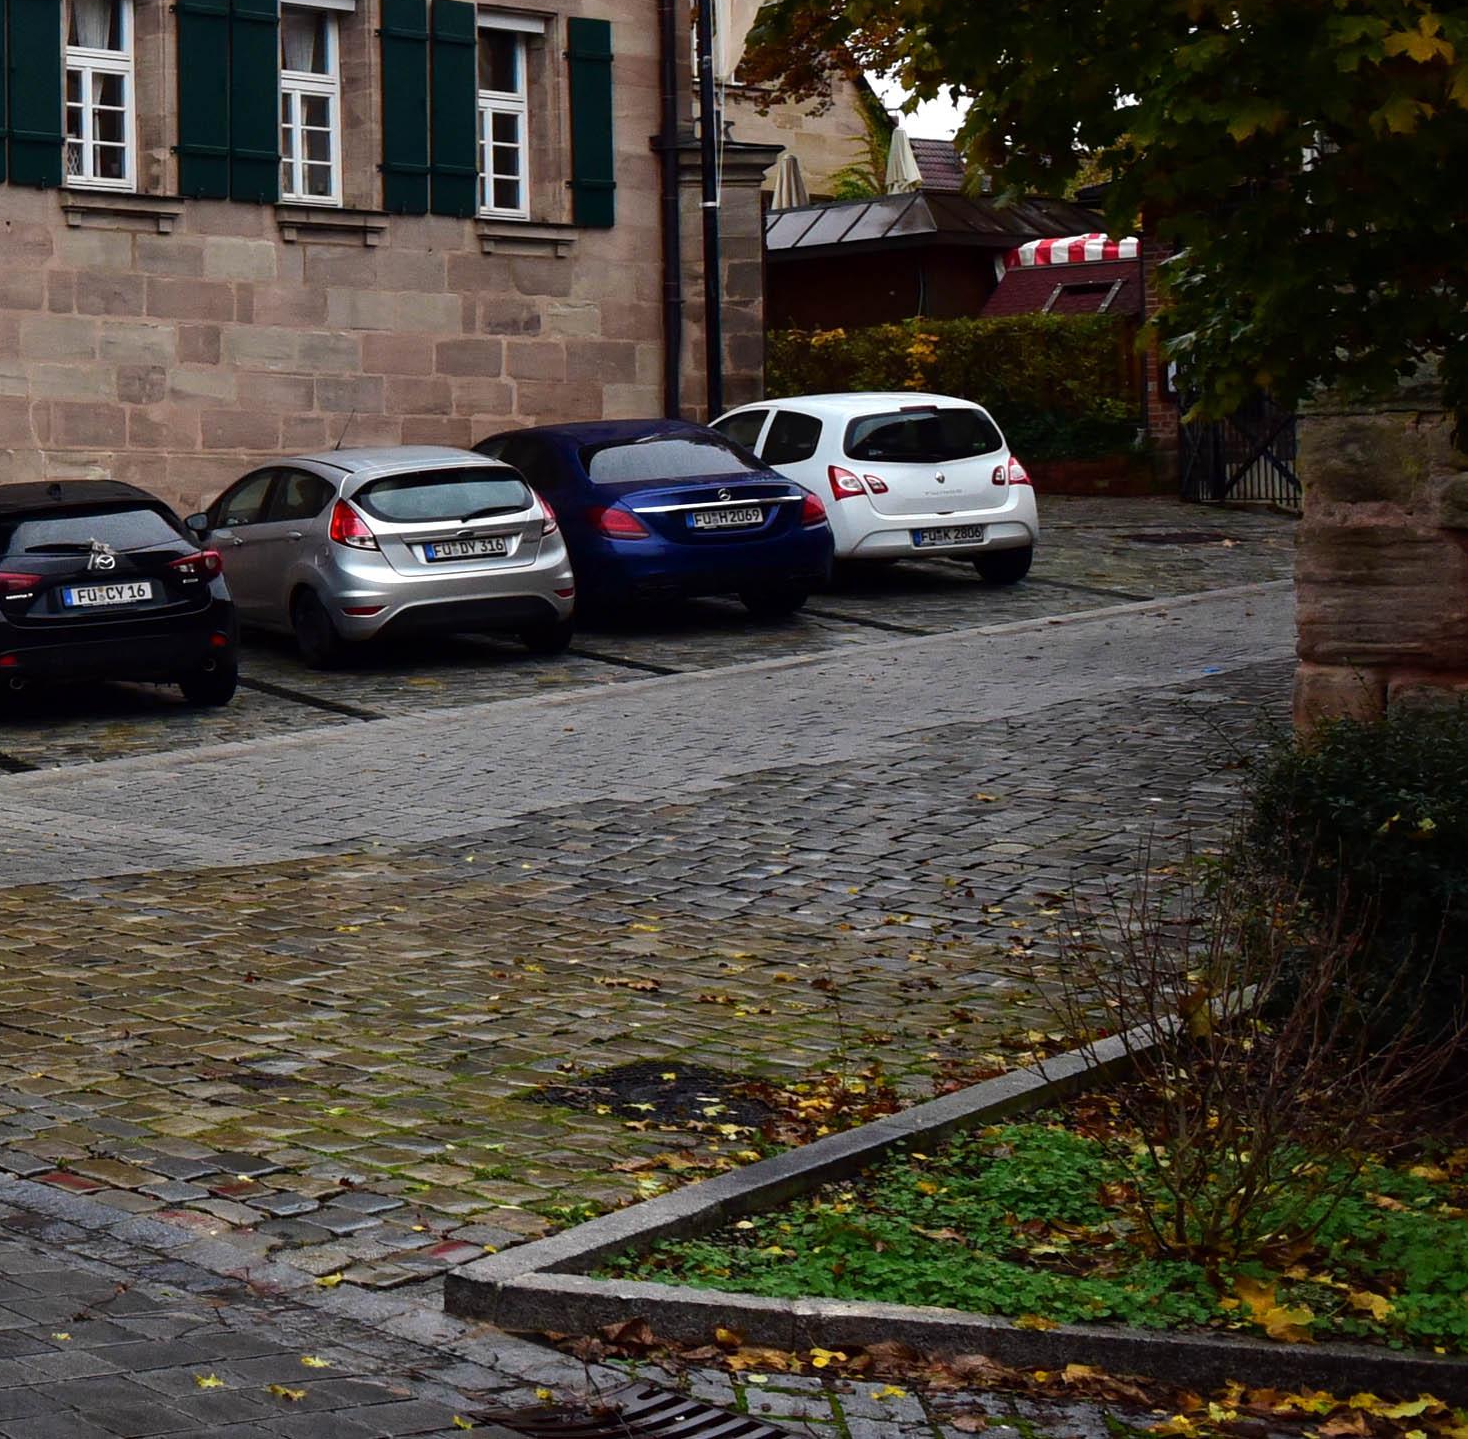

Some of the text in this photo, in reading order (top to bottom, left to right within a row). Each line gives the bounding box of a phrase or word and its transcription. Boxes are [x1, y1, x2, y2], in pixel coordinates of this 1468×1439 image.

[718, 511, 728, 523] H
[728, 509, 760, 523] 2069
[943, 528, 952, 540] K
[460, 541, 476, 554] DY
[480, 539, 504, 552] 316
[106, 585, 125, 601] CY
[129, 584, 147, 599] 16
